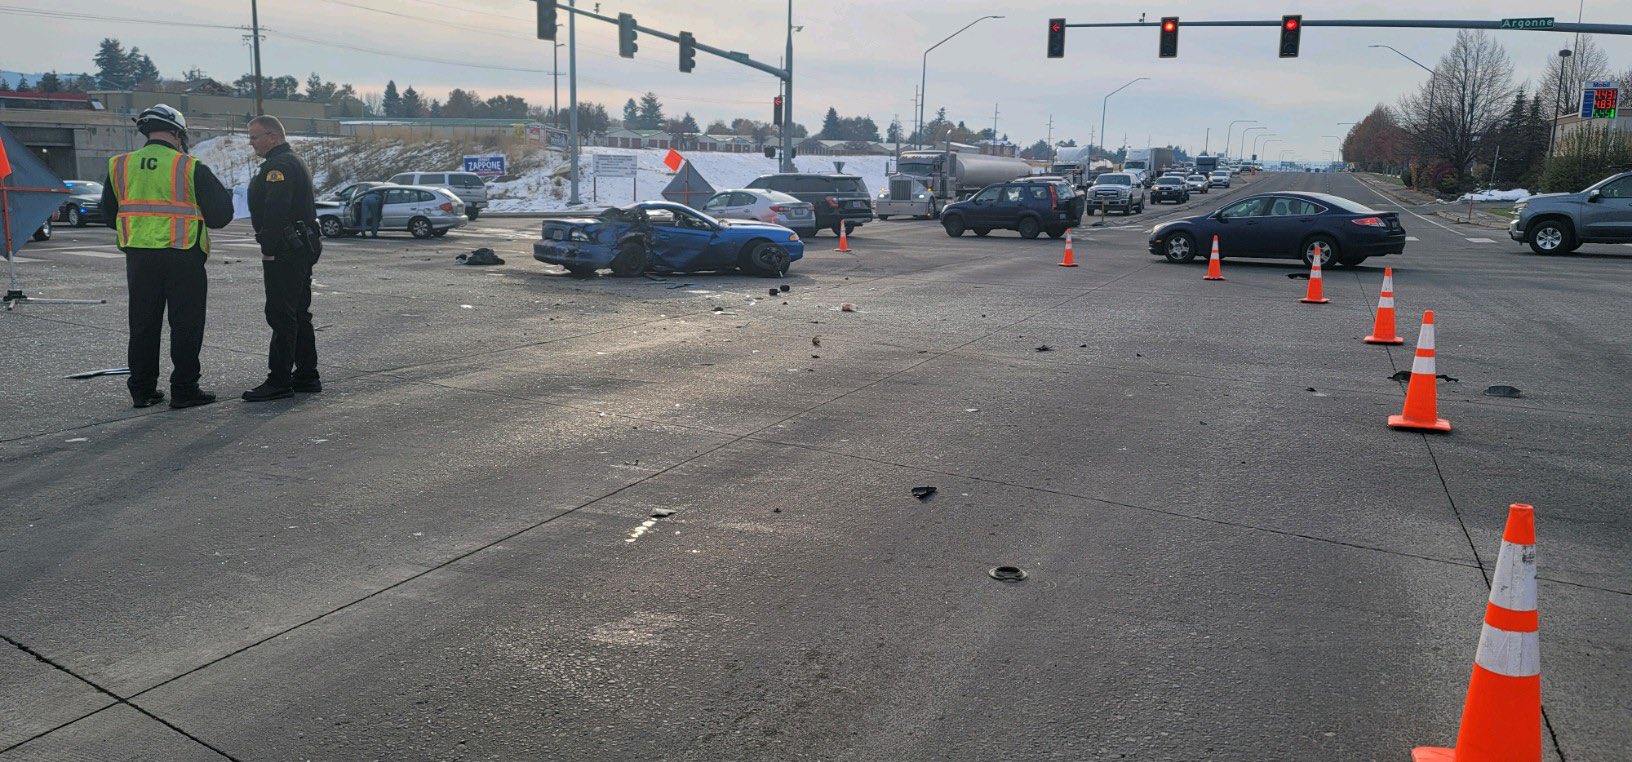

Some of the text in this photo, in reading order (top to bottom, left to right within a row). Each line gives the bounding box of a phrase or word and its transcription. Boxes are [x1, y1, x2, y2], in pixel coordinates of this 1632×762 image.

[1502, 19, 1553, 28] Argonne
[140, 157, 158, 170] IC
[468, 161, 501, 171] ZAPPONE
